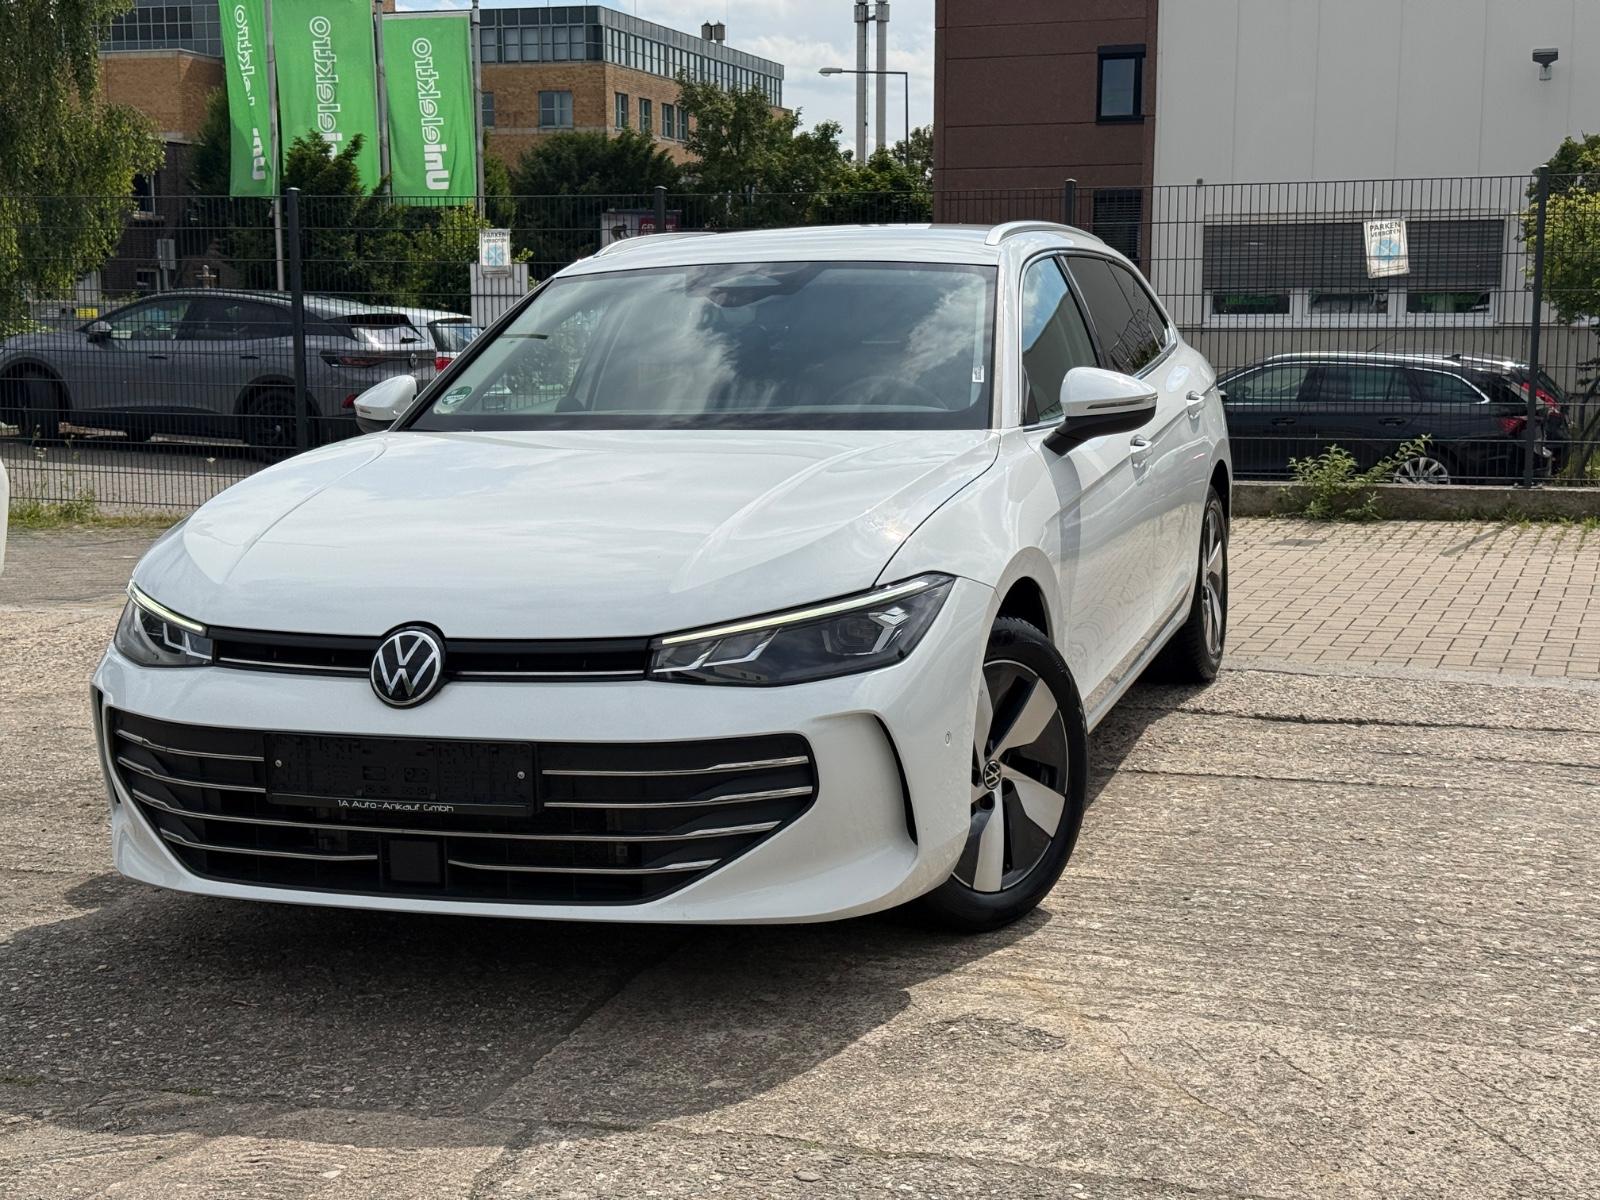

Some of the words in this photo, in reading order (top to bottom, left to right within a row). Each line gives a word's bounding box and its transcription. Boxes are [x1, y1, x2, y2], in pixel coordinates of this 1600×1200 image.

[1369, 222, 1401, 231] PARKEN
[374, 632, 440, 699] VW
[338, 799, 350, 808] 1A
